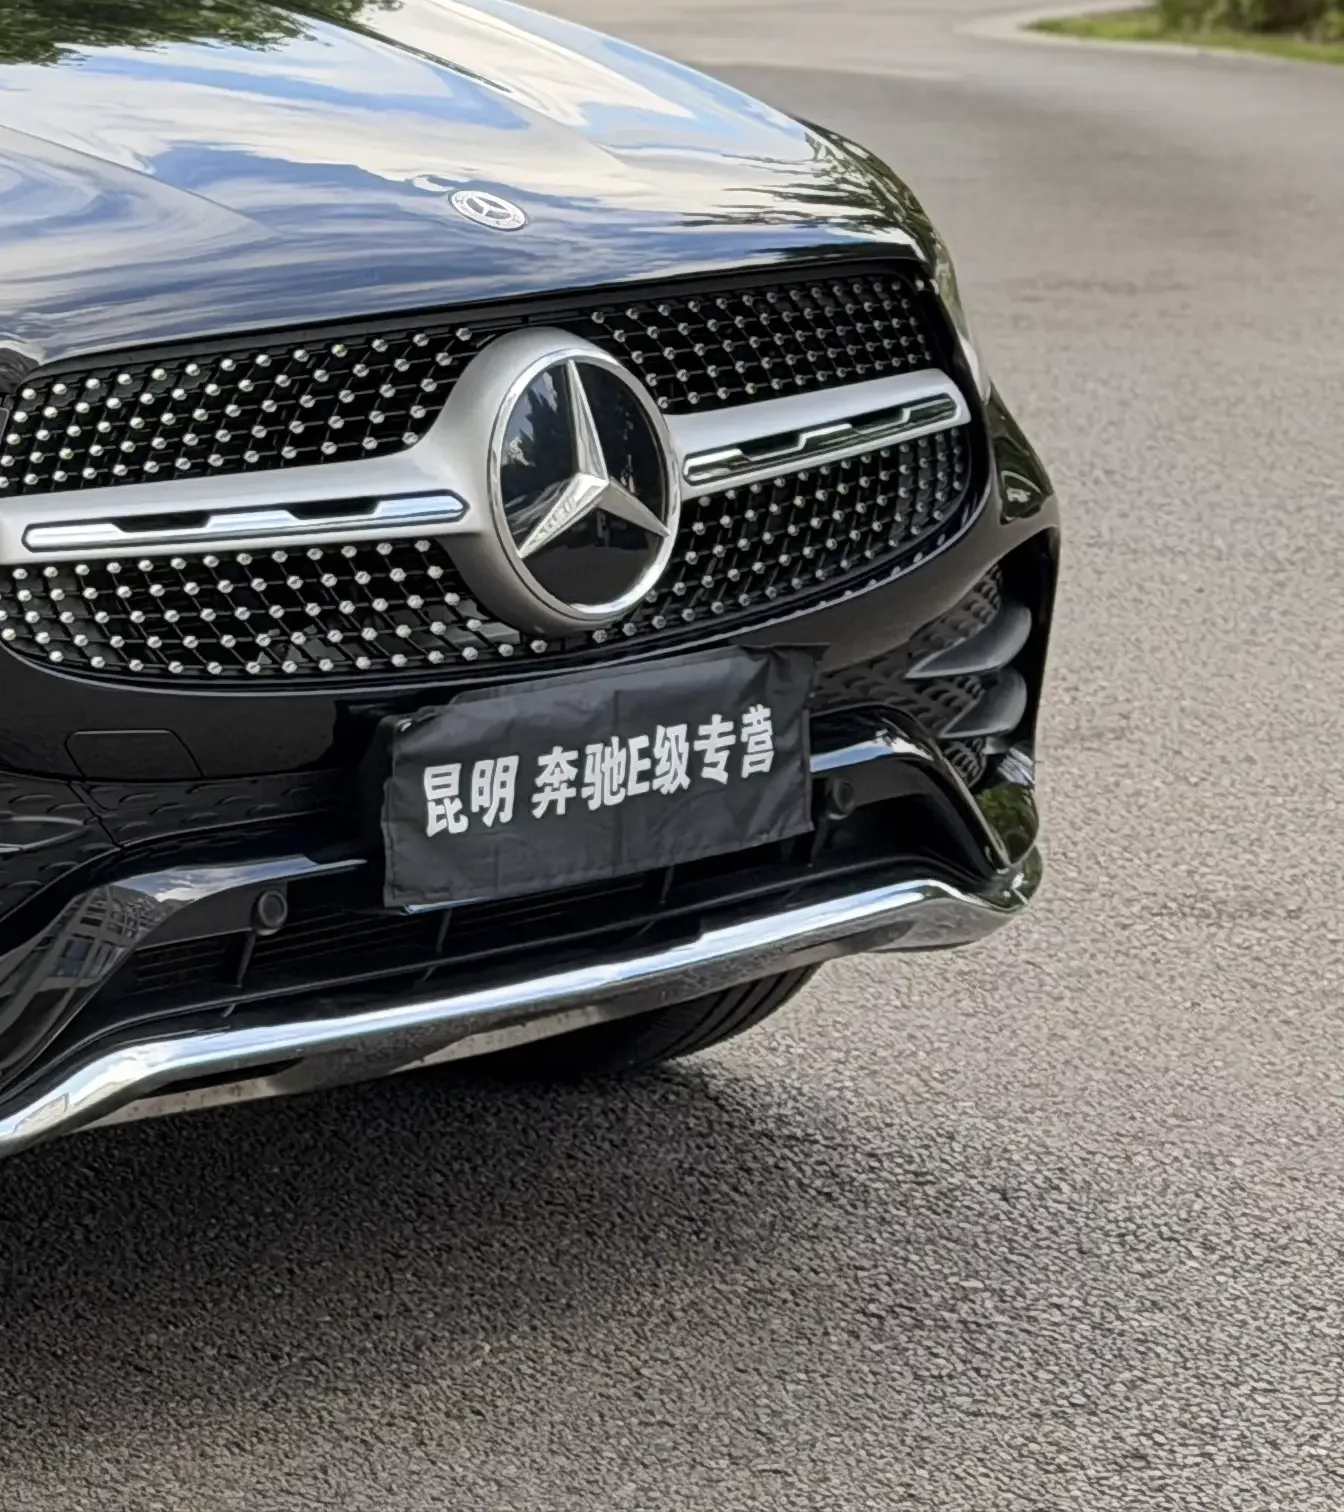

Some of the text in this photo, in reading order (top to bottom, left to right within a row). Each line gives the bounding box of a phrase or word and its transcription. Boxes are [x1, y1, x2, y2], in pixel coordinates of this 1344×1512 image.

[422, 703, 775, 838] 昆明 奔驰E级专营
